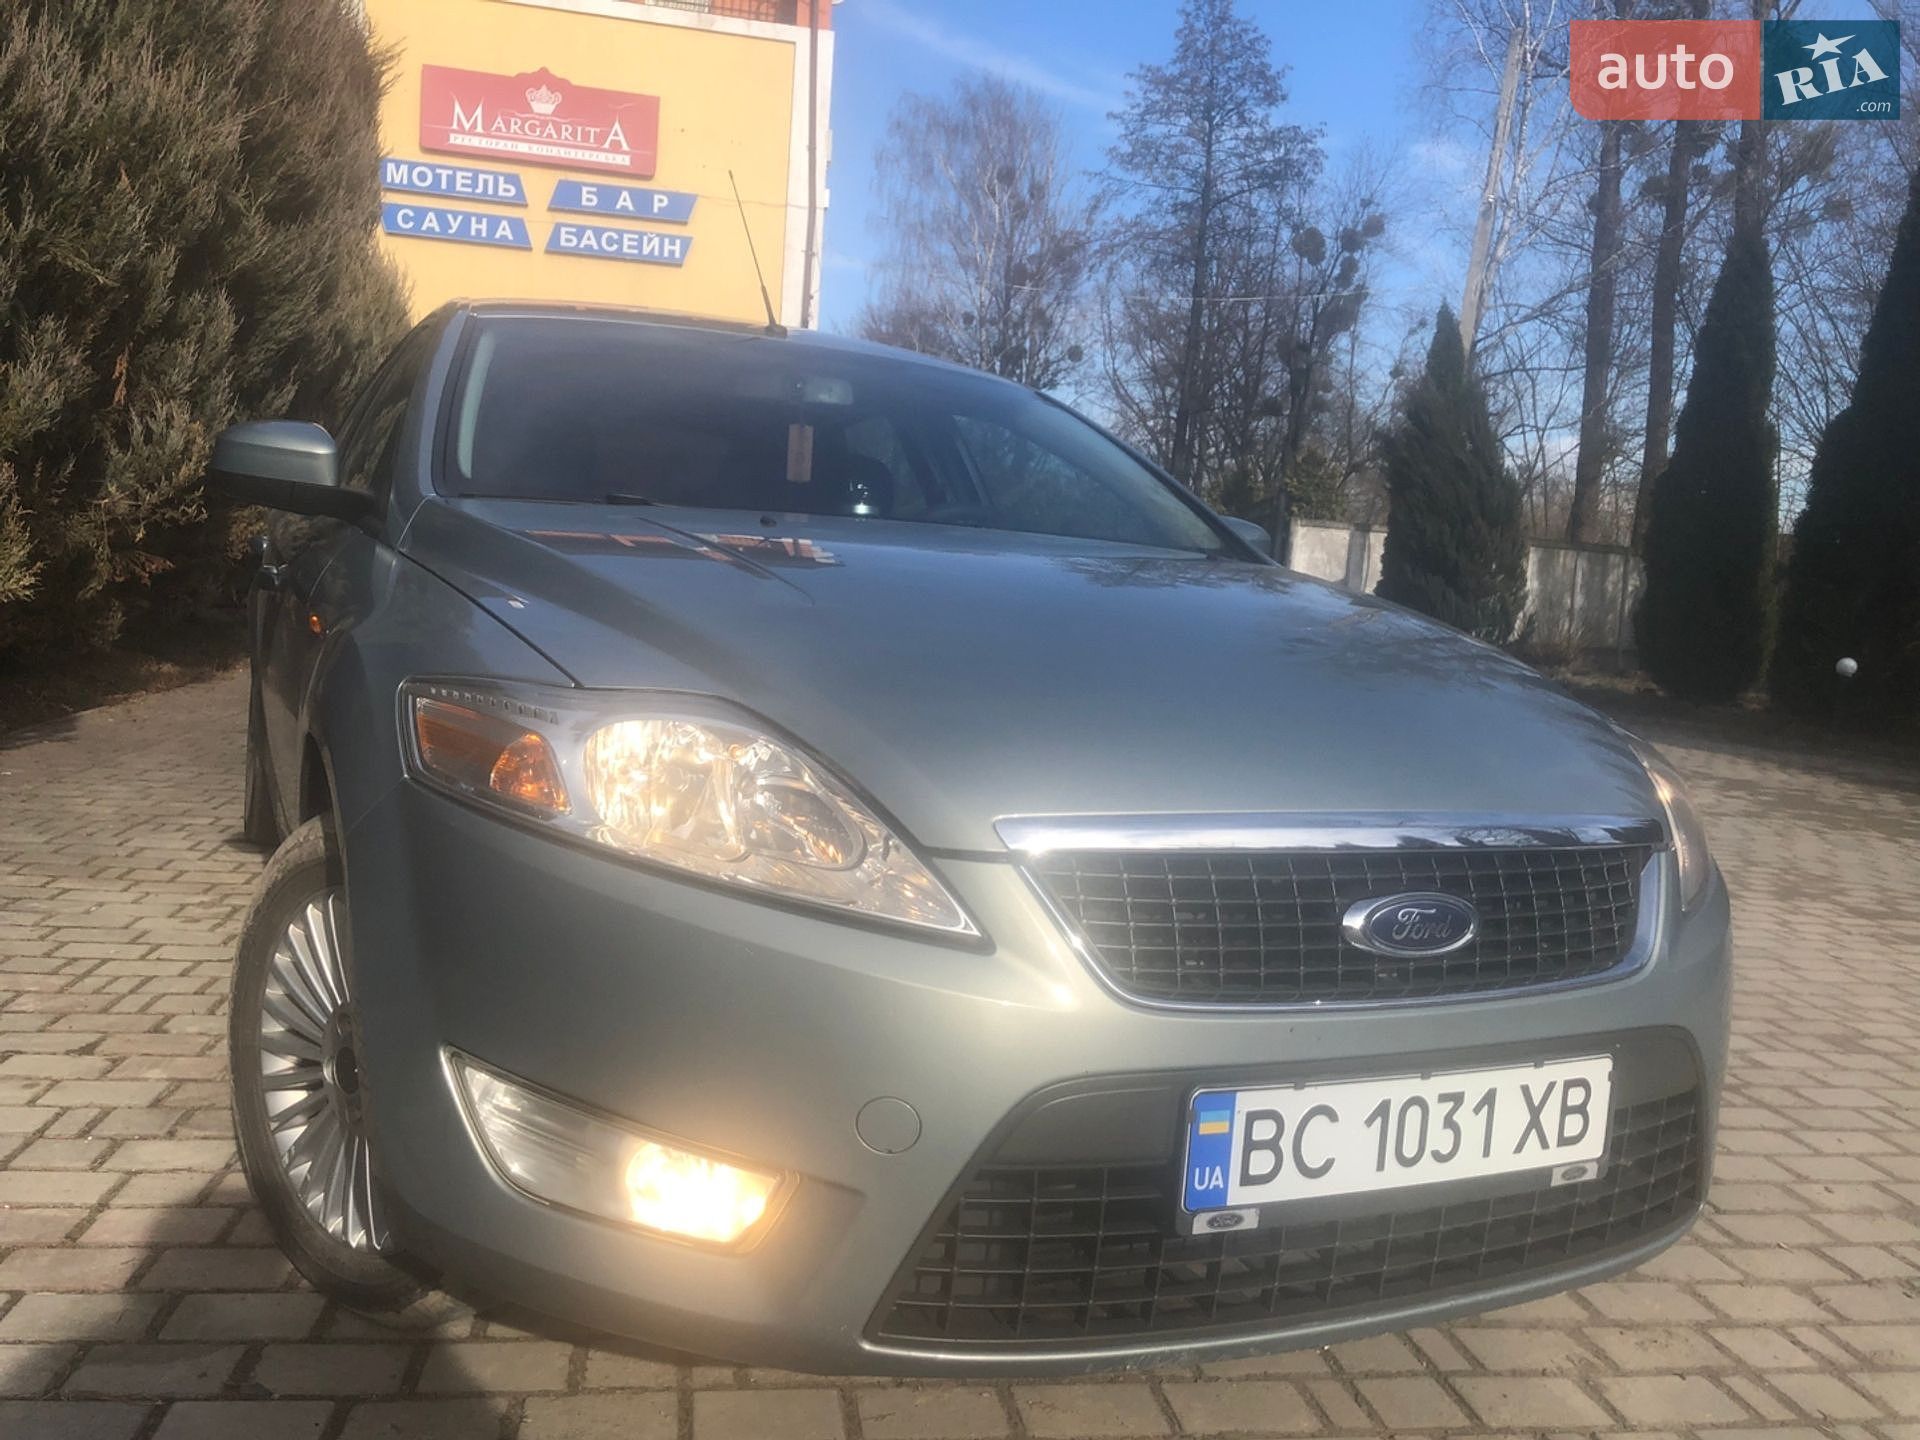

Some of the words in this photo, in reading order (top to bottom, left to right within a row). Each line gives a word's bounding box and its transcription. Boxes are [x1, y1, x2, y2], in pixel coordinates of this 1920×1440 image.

[386, 162, 518, 198] МОТЕЛЬ
[581, 185, 669, 213] БАР
[396, 208, 514, 241] САУНА
[559, 226, 682, 259] БАСЕЙН
[1391, 908, 1452, 940] Ford
[1239, 1103, 1340, 1187] BC
[1363, 1087, 1498, 1174] 1031
[1512, 1077, 1593, 1155] XB
[1194, 1166, 1224, 1191] UA
